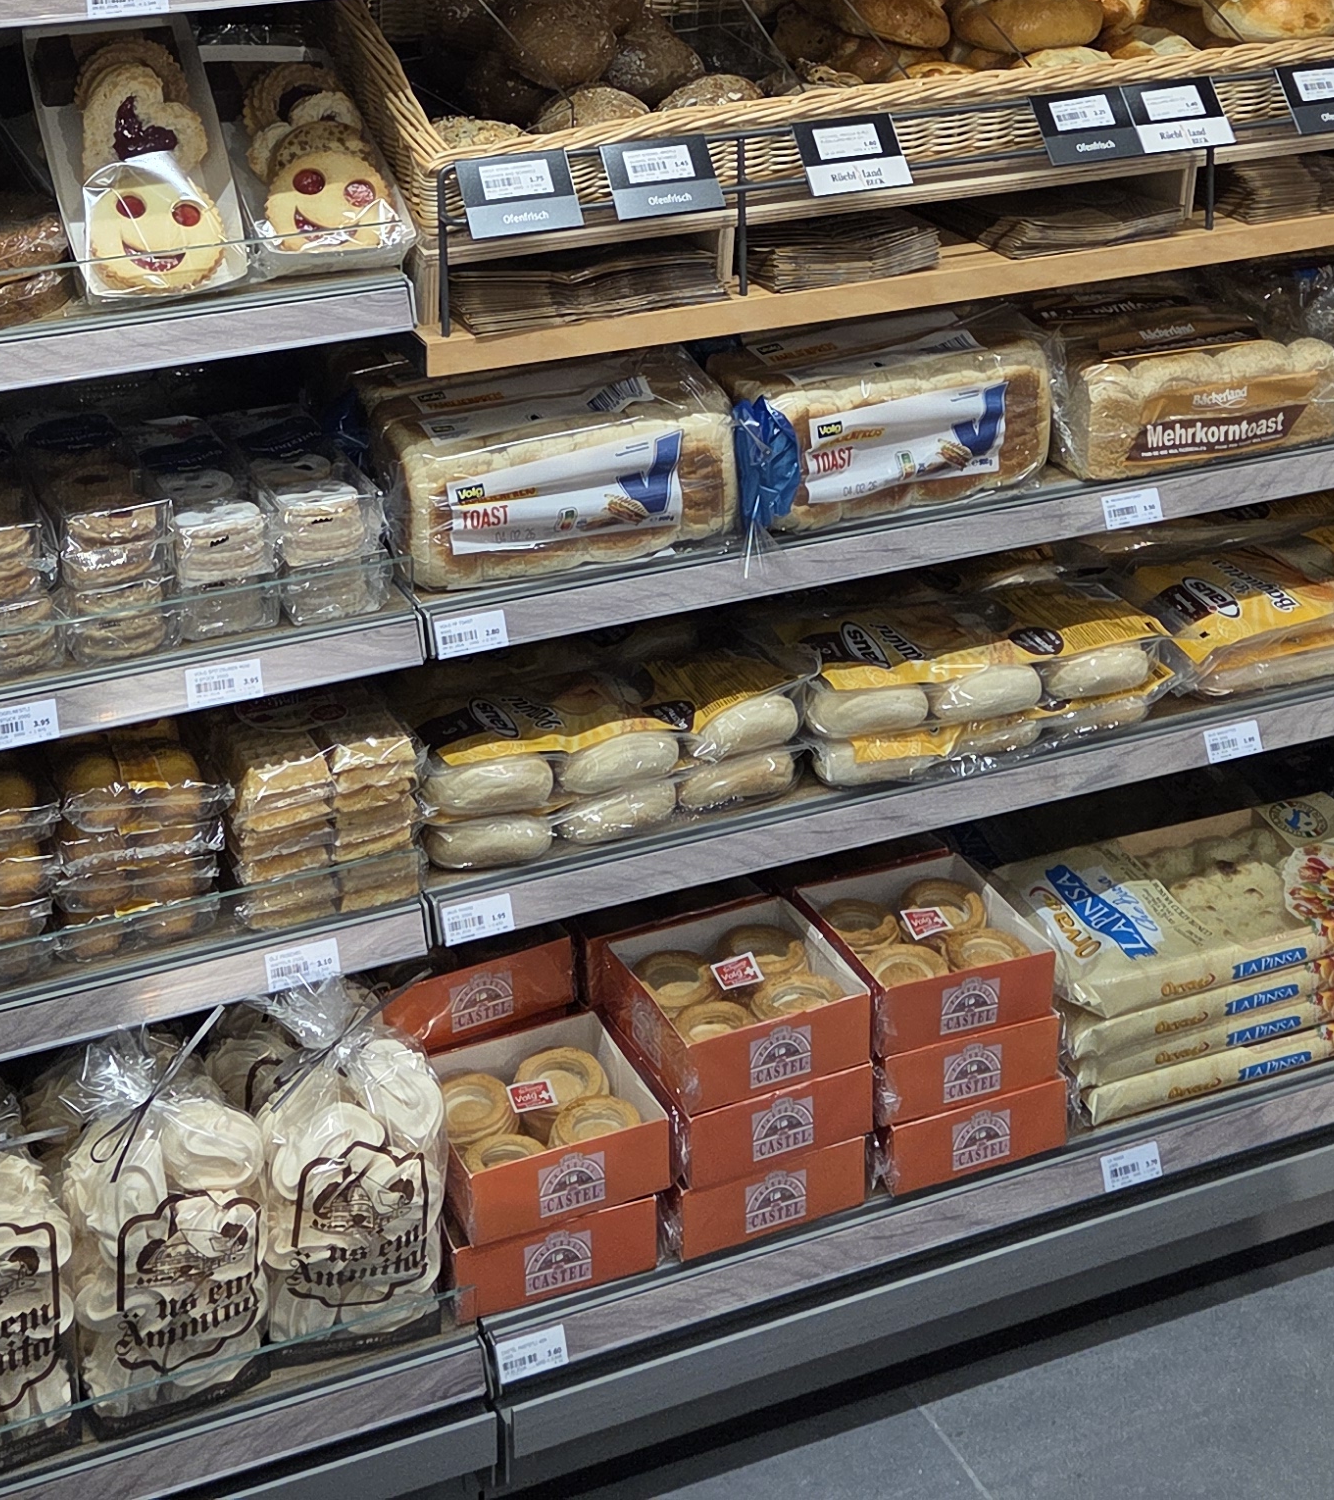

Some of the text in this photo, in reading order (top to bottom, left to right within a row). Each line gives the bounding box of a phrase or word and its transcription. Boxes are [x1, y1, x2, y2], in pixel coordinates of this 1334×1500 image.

[647, 191, 692, 208] Ofenfrisch
[502, 208, 550, 224] Ofenfrisch
[819, 424, 842, 436] Volg
[1146, 411, 1285, 449] Mehrkorntoast
[812, 446, 853, 474] TOAST
[457, 486, 484, 499] Volg
[461, 505, 509, 529] TOAST
[33, 718, 50, 726] 3.95
[910, 915, 936, 932] Volg
[721, 968, 745, 984] Volg
[454, 1004, 513, 1031] CASTEL
[941, 1008, 998, 1033] CASTEL
[751, 1059, 811, 1087] CASTEL
[515, 1091, 540, 1106] Volg
[945, 1074, 1000, 1101] CASTEL
[754, 1132, 813, 1160] CASTEL
[953, 1141, 1009, 1169] CASTEL
[542, 1186, 606, 1216] CASTEL
[748, 1203, 806, 1231] CASTEL
[527, 1265, 591, 1294] CASTEL
